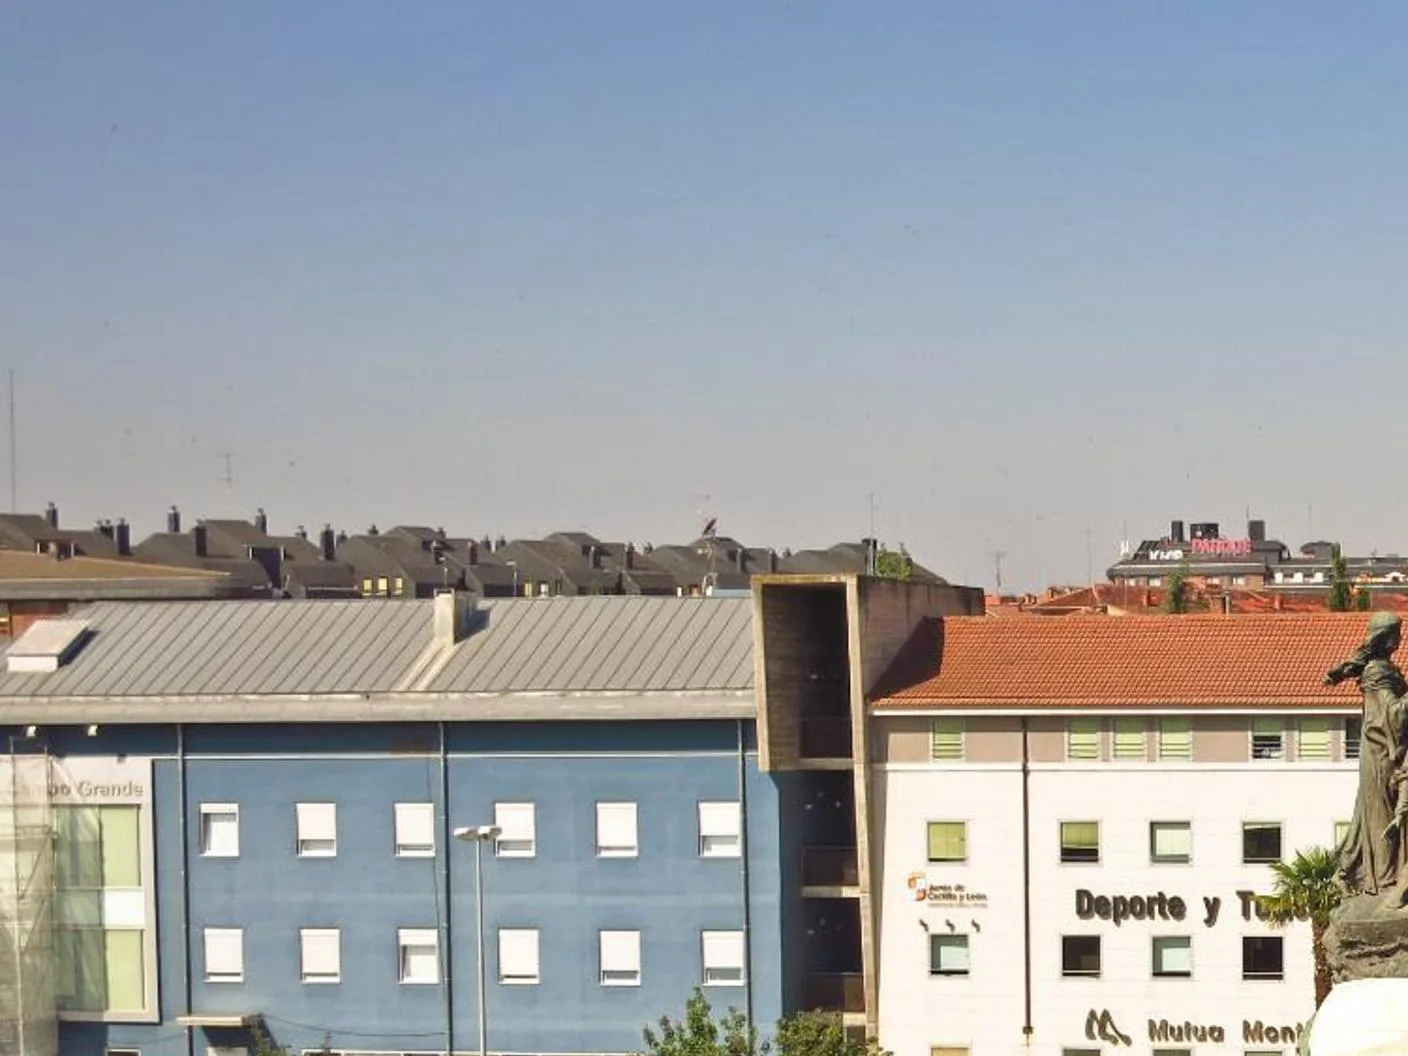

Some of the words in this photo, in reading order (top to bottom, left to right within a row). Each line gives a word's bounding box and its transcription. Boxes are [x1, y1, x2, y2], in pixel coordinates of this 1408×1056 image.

[78, 780, 144, 797] Grande
[1075, 889, 1187, 928] Deporte
[1203, 896, 1221, 928] y
[1148, 1018, 1225, 1042] Mutua
